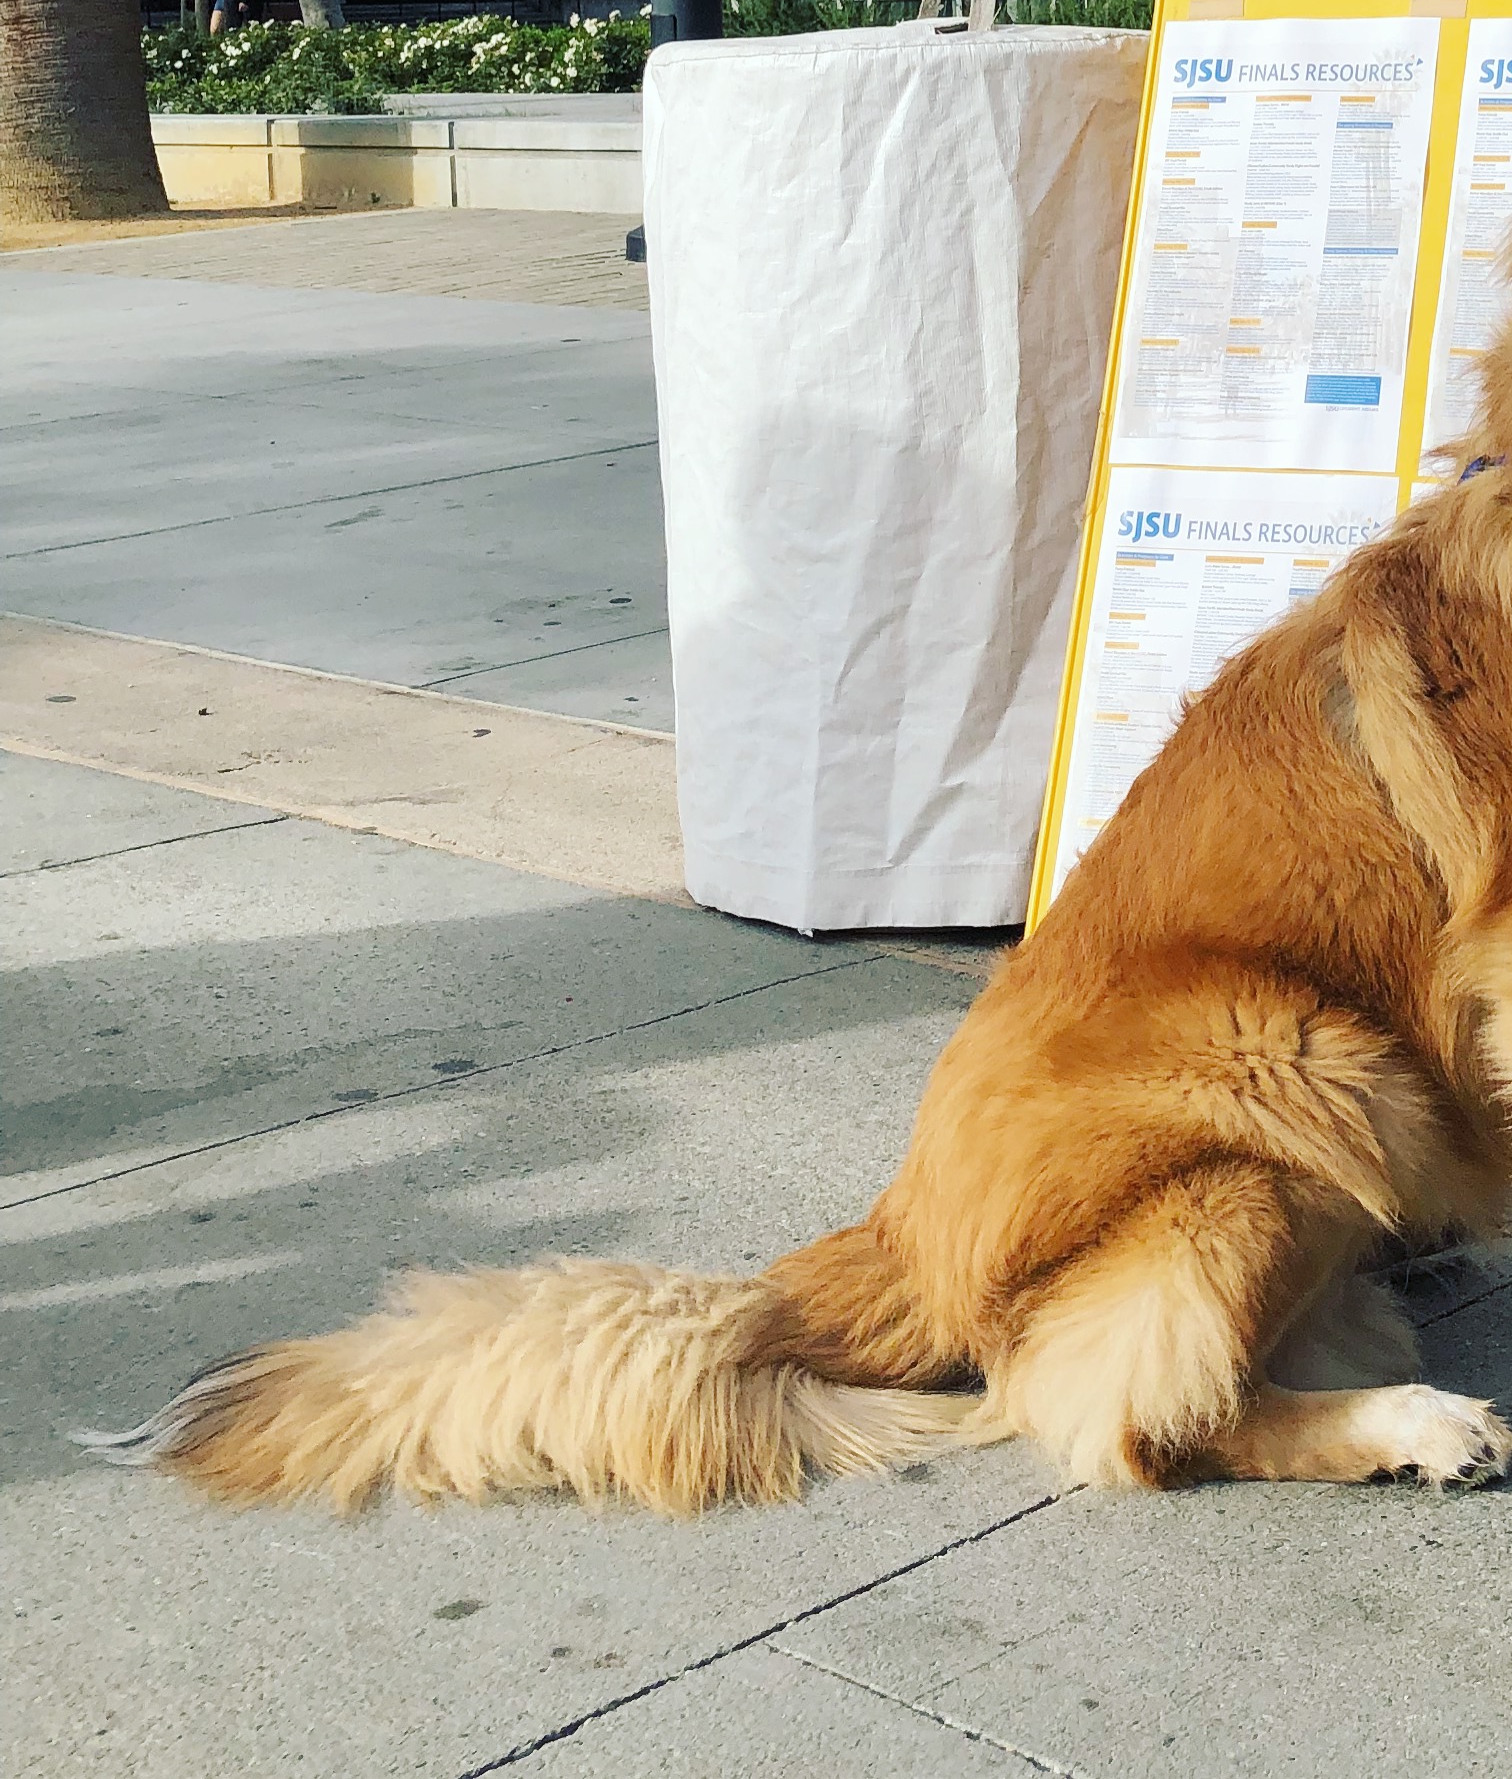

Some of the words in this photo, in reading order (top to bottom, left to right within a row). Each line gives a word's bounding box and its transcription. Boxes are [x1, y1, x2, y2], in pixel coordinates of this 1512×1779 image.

[1173, 58, 1234, 89] SJSU
[1238, 63, 1300, 83] FINALS
[1305, 61, 1415, 82] RESOURCES
[1117, 509, 1183, 544] SJSU
[1186, 520, 1253, 542] FINALS
[1257, 523, 1371, 546] RESOURCES
